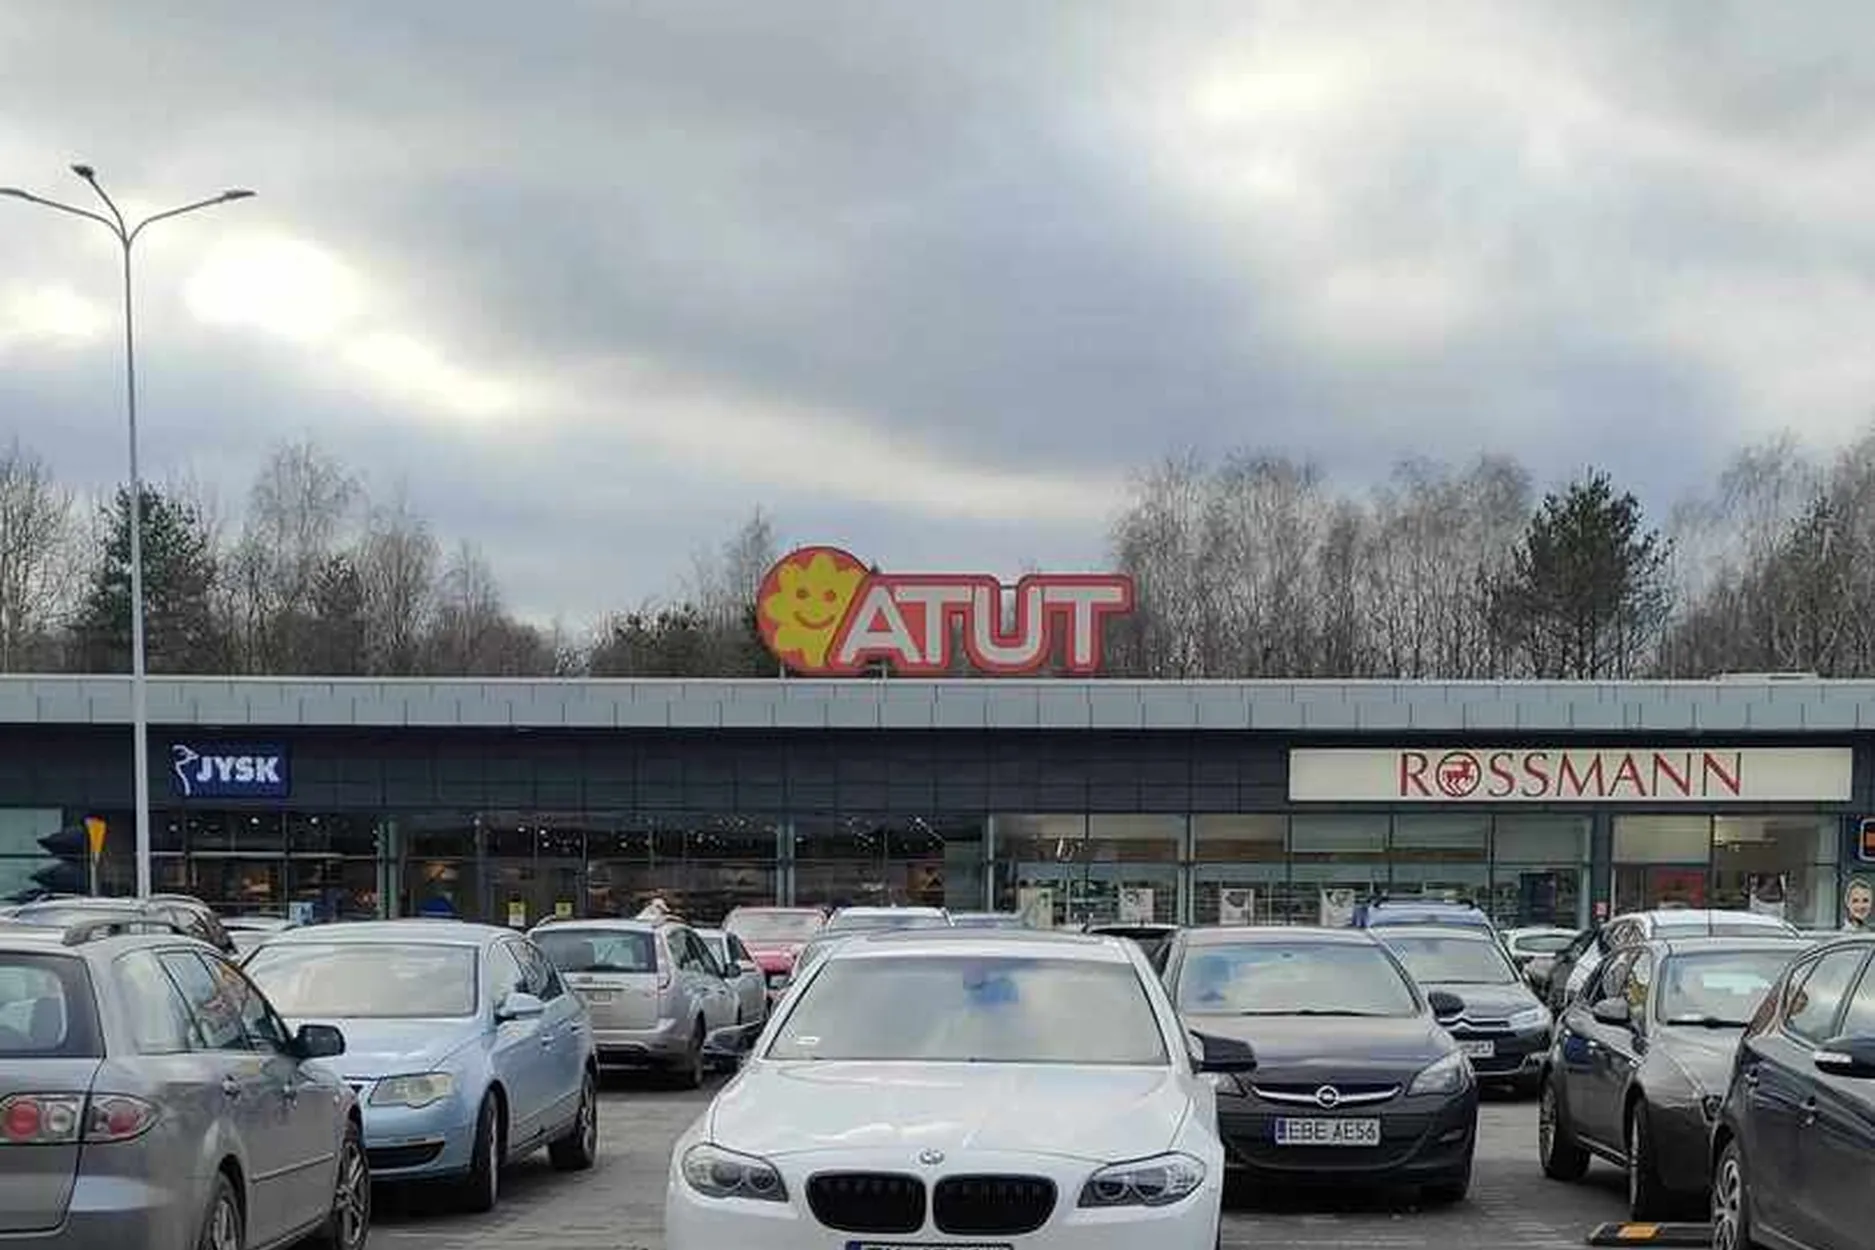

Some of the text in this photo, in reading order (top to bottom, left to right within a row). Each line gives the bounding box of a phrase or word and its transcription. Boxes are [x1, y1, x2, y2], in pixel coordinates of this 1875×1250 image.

[838, 583, 1123, 665] ATUT
[196, 756, 280, 782] JYSK
[1399, 751, 1742, 798] ROSSMANN
